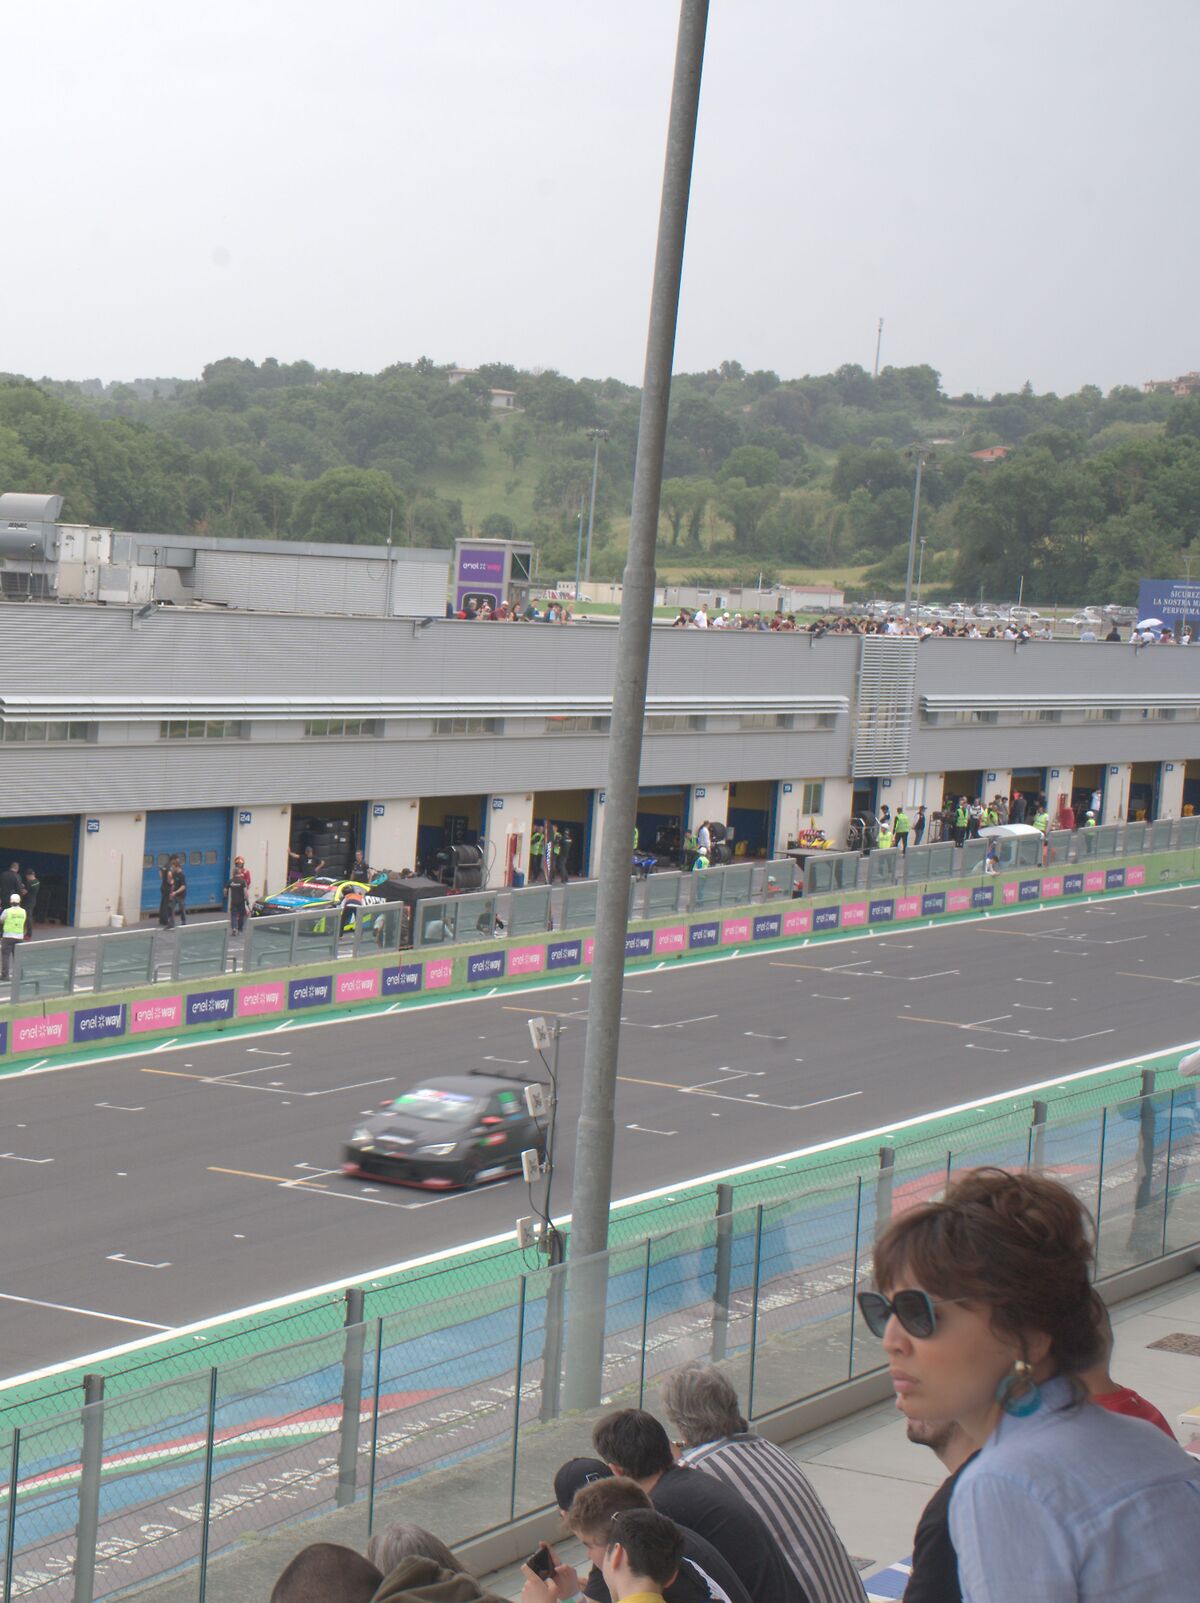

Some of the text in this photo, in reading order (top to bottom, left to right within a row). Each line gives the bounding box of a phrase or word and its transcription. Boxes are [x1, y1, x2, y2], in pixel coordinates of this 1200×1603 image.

[374, 806, 384, 815] 23
[493, 800, 503, 808] 22
[240, 813, 251, 822] 24
[87, 822, 99, 830] 25
[386, 972, 417, 985] enel way
[430, 968, 444, 979] enel
[294, 983, 327, 998] enel way
[341, 977, 373, 992] enel way
[243, 990, 279, 1006] enel way
[192, 999, 228, 1014] enel way
[137, 1008, 176, 1021] enel way
[80, 1014, 121, 1030] enel way
[19, 1024, 62, 1040] enel way
